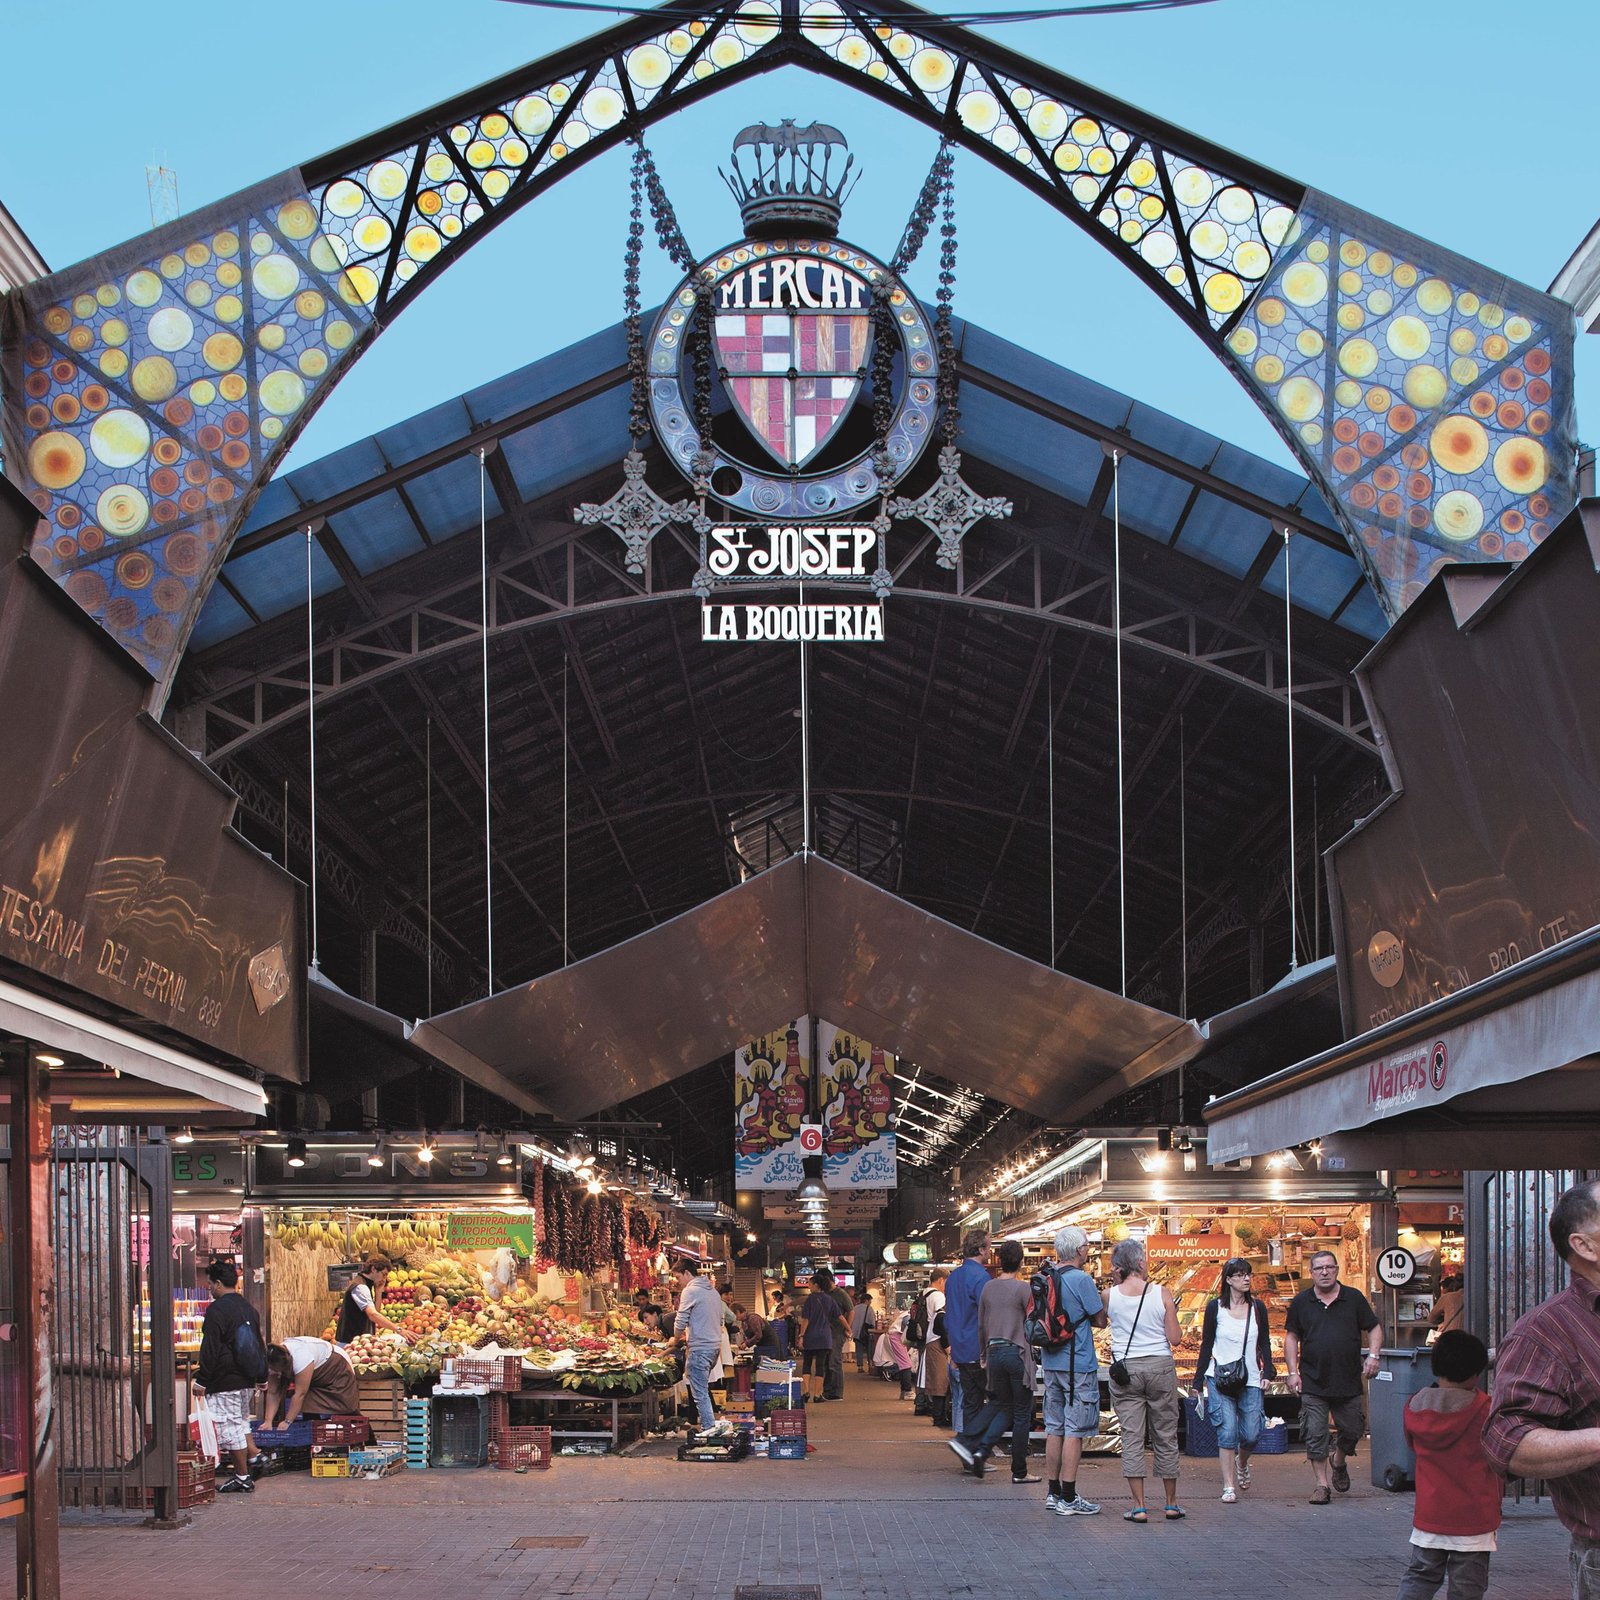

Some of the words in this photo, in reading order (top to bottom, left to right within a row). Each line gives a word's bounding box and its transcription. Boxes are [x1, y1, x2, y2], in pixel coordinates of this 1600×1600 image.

[720, 258, 866, 309] MERCAT
[747, 527, 877, 576] JOSEP
[702, 605, 738, 641] LA
[746, 605, 884, 641] BOQUERIA
[96, 938, 130, 986] DEL
[131, 955, 187, 1013] PERNIL
[1367, 1056, 1427, 1105] Marcos
[806, 1132, 816, 1147] 6
[282, 1151, 488, 1178] PONS
[450, 1216, 530, 1225] MEDITERRANEAN
[451, 1227, 457, 1235] &
[462, 1226, 507, 1235] TROPICAL
[451, 1236, 512, 1246] MACEDONIA
[1178, 1238, 1199, 1247] ONLY
[1149, 1248, 1184, 1258] CATALAN
[1185, 1248, 1229, 1257] CHOCOLAT
[1386, 1253, 1406, 1269] 10
[1387, 1272, 1406, 1280] Jeep
